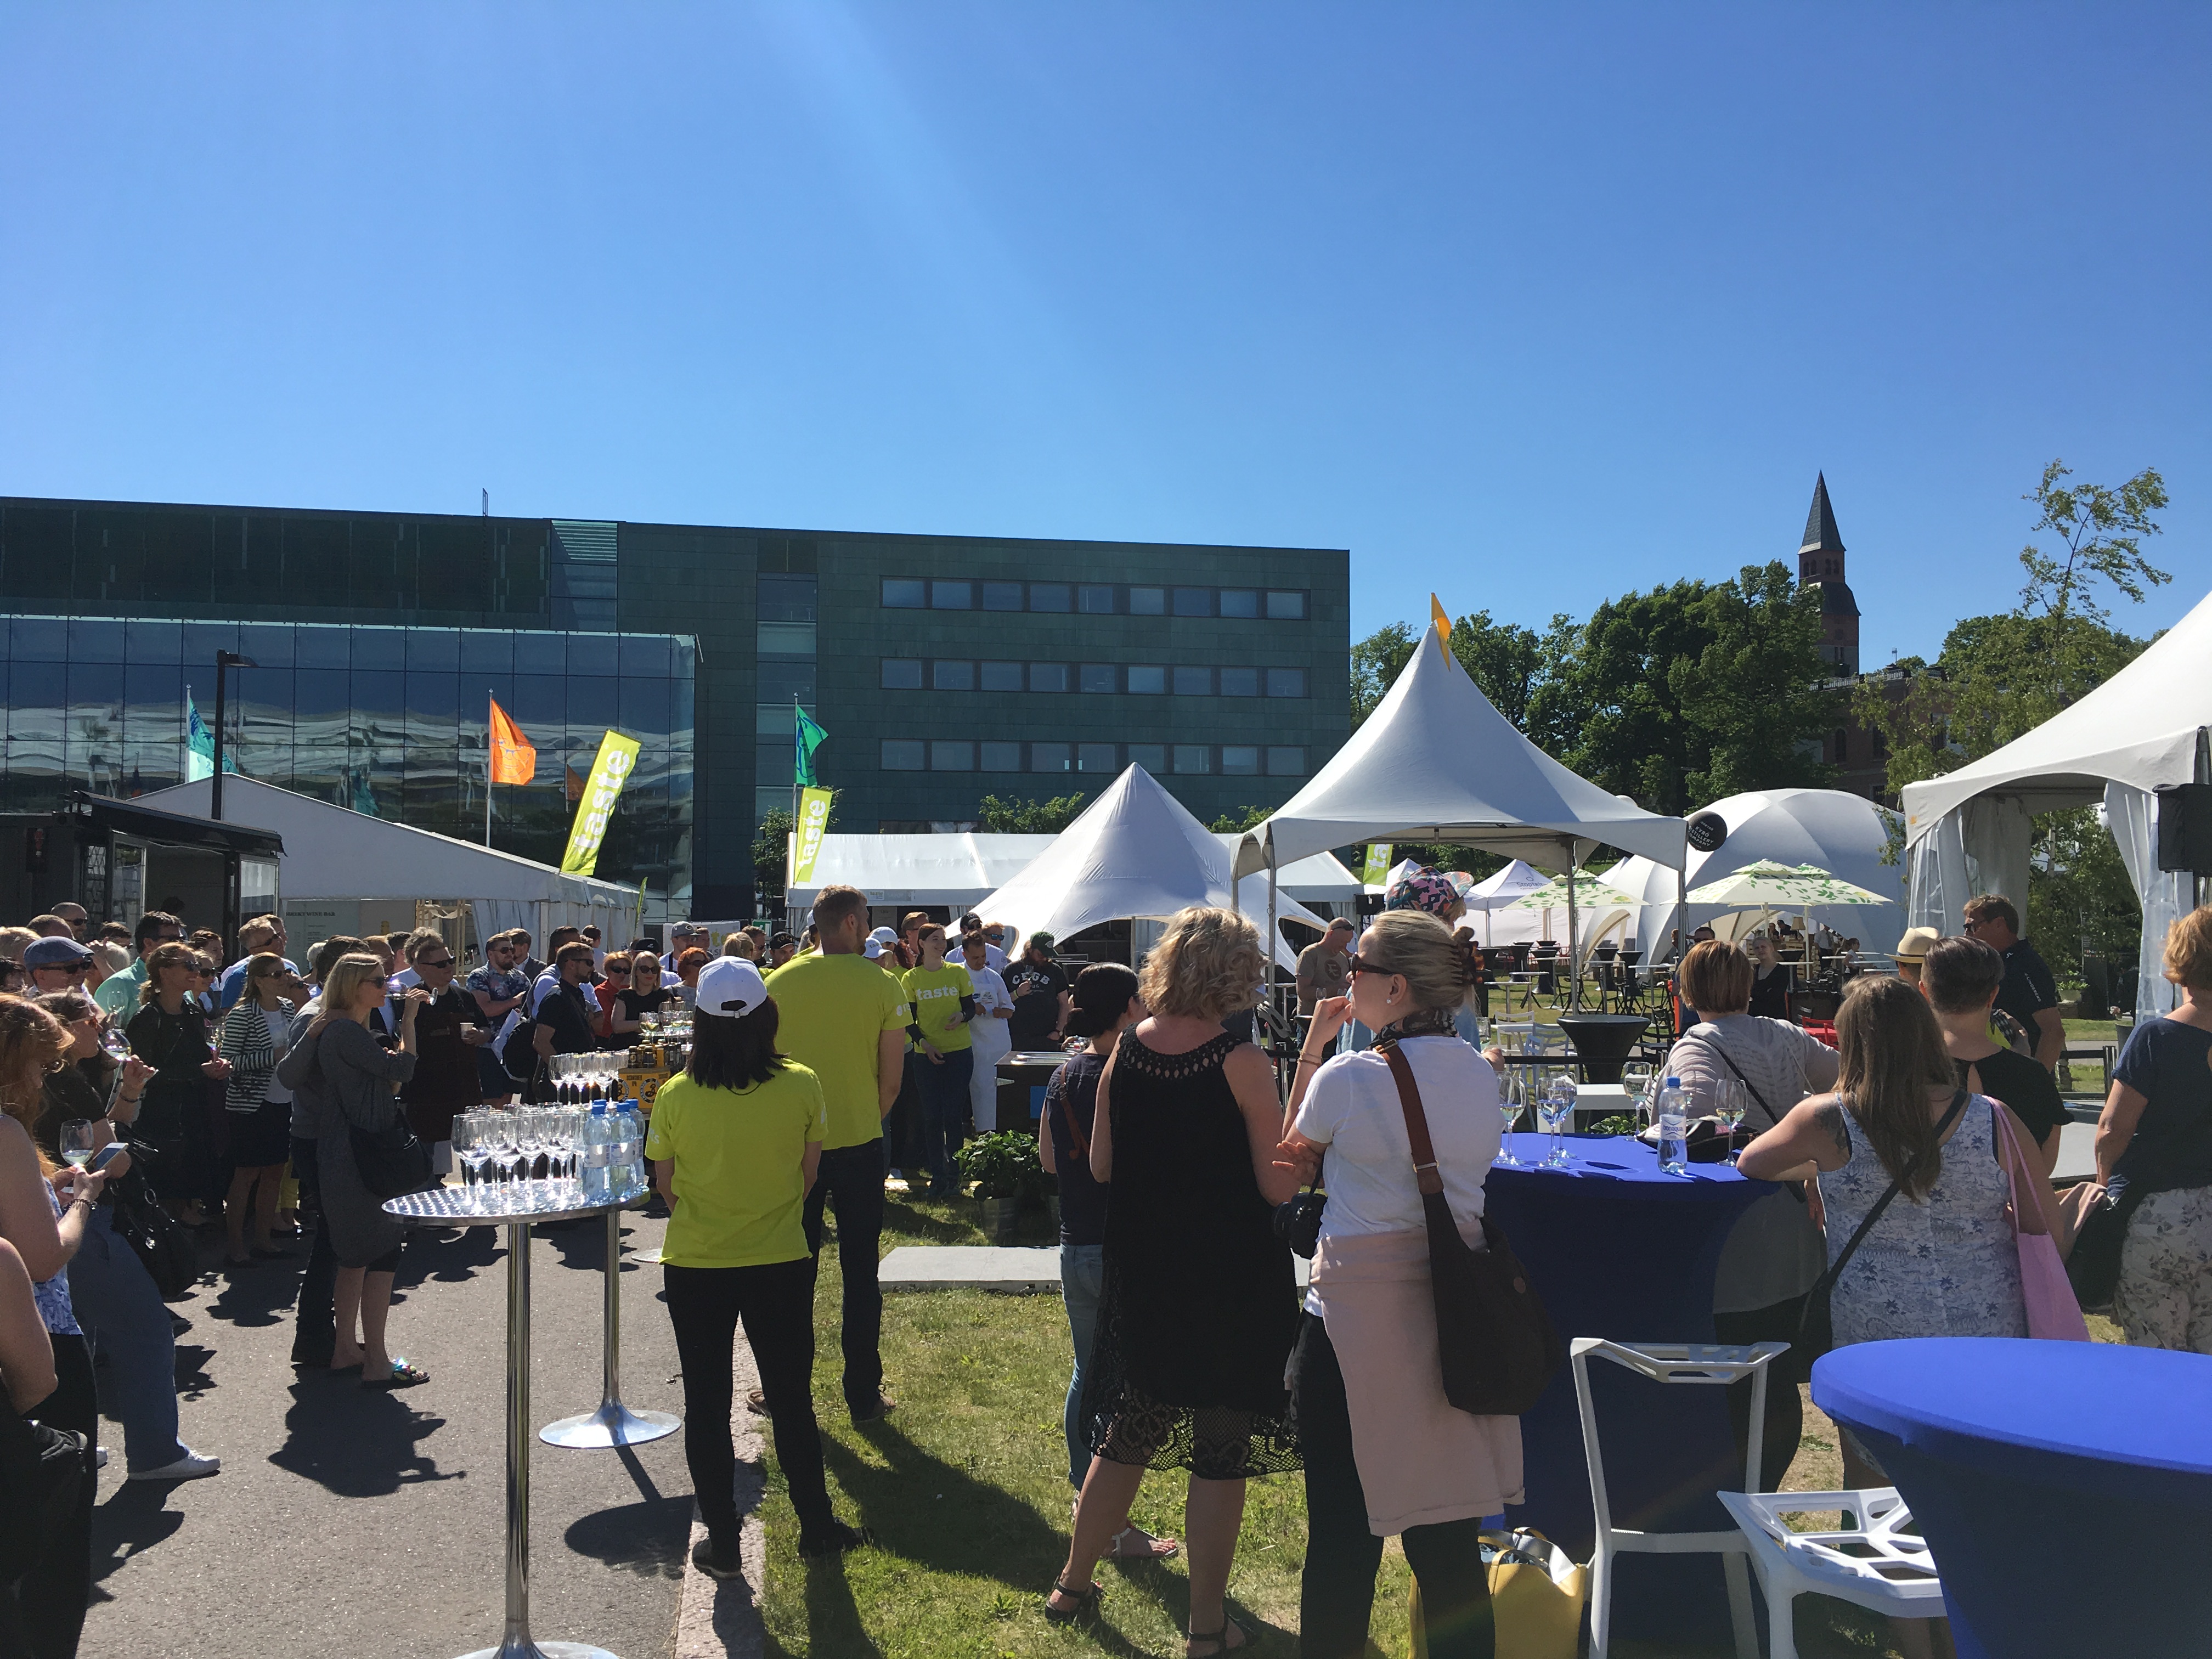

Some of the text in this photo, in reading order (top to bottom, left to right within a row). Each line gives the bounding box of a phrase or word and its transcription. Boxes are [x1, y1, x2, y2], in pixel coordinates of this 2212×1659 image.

[574, 749, 630, 853] taste
[798, 800, 826, 868] taste
[1688, 830, 1711, 846] OMPANY
[1695, 826, 1709, 837] KYRÖ
[917, 985, 958, 1000] taste
